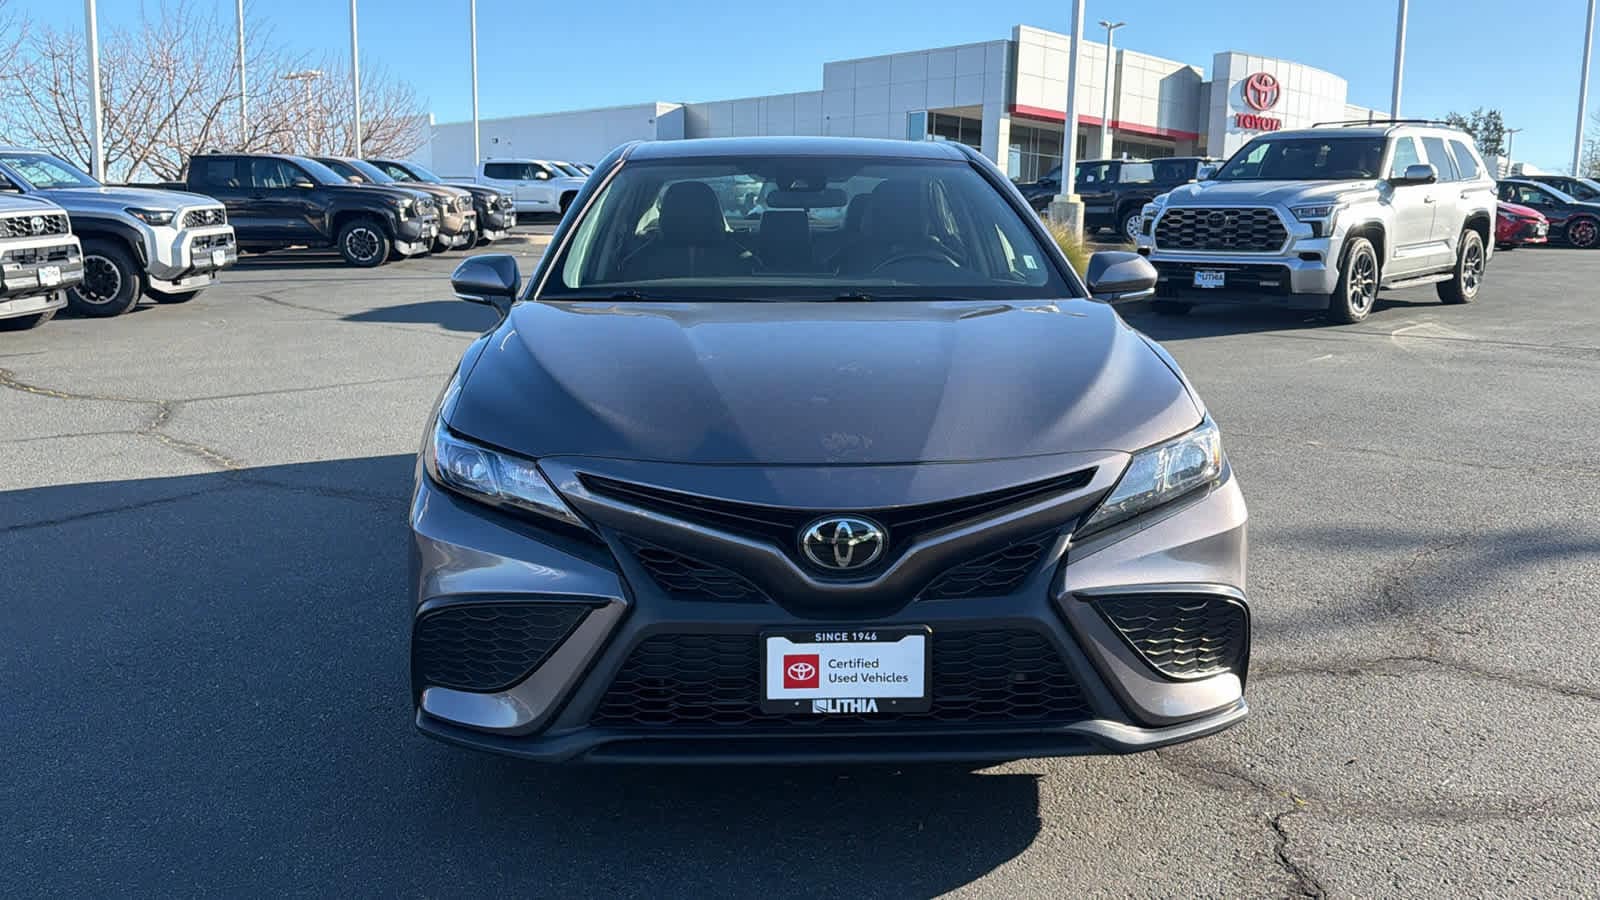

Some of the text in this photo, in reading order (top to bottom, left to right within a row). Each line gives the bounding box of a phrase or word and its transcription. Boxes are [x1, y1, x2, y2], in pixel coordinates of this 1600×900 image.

[1235, 113, 1281, 131] TOYOTA
[815, 631, 878, 641] SINCE 1946
[828, 658, 880, 669] Certified
[828, 673, 909, 683] Used Vehicles
[828, 699, 878, 713] LITHIA
